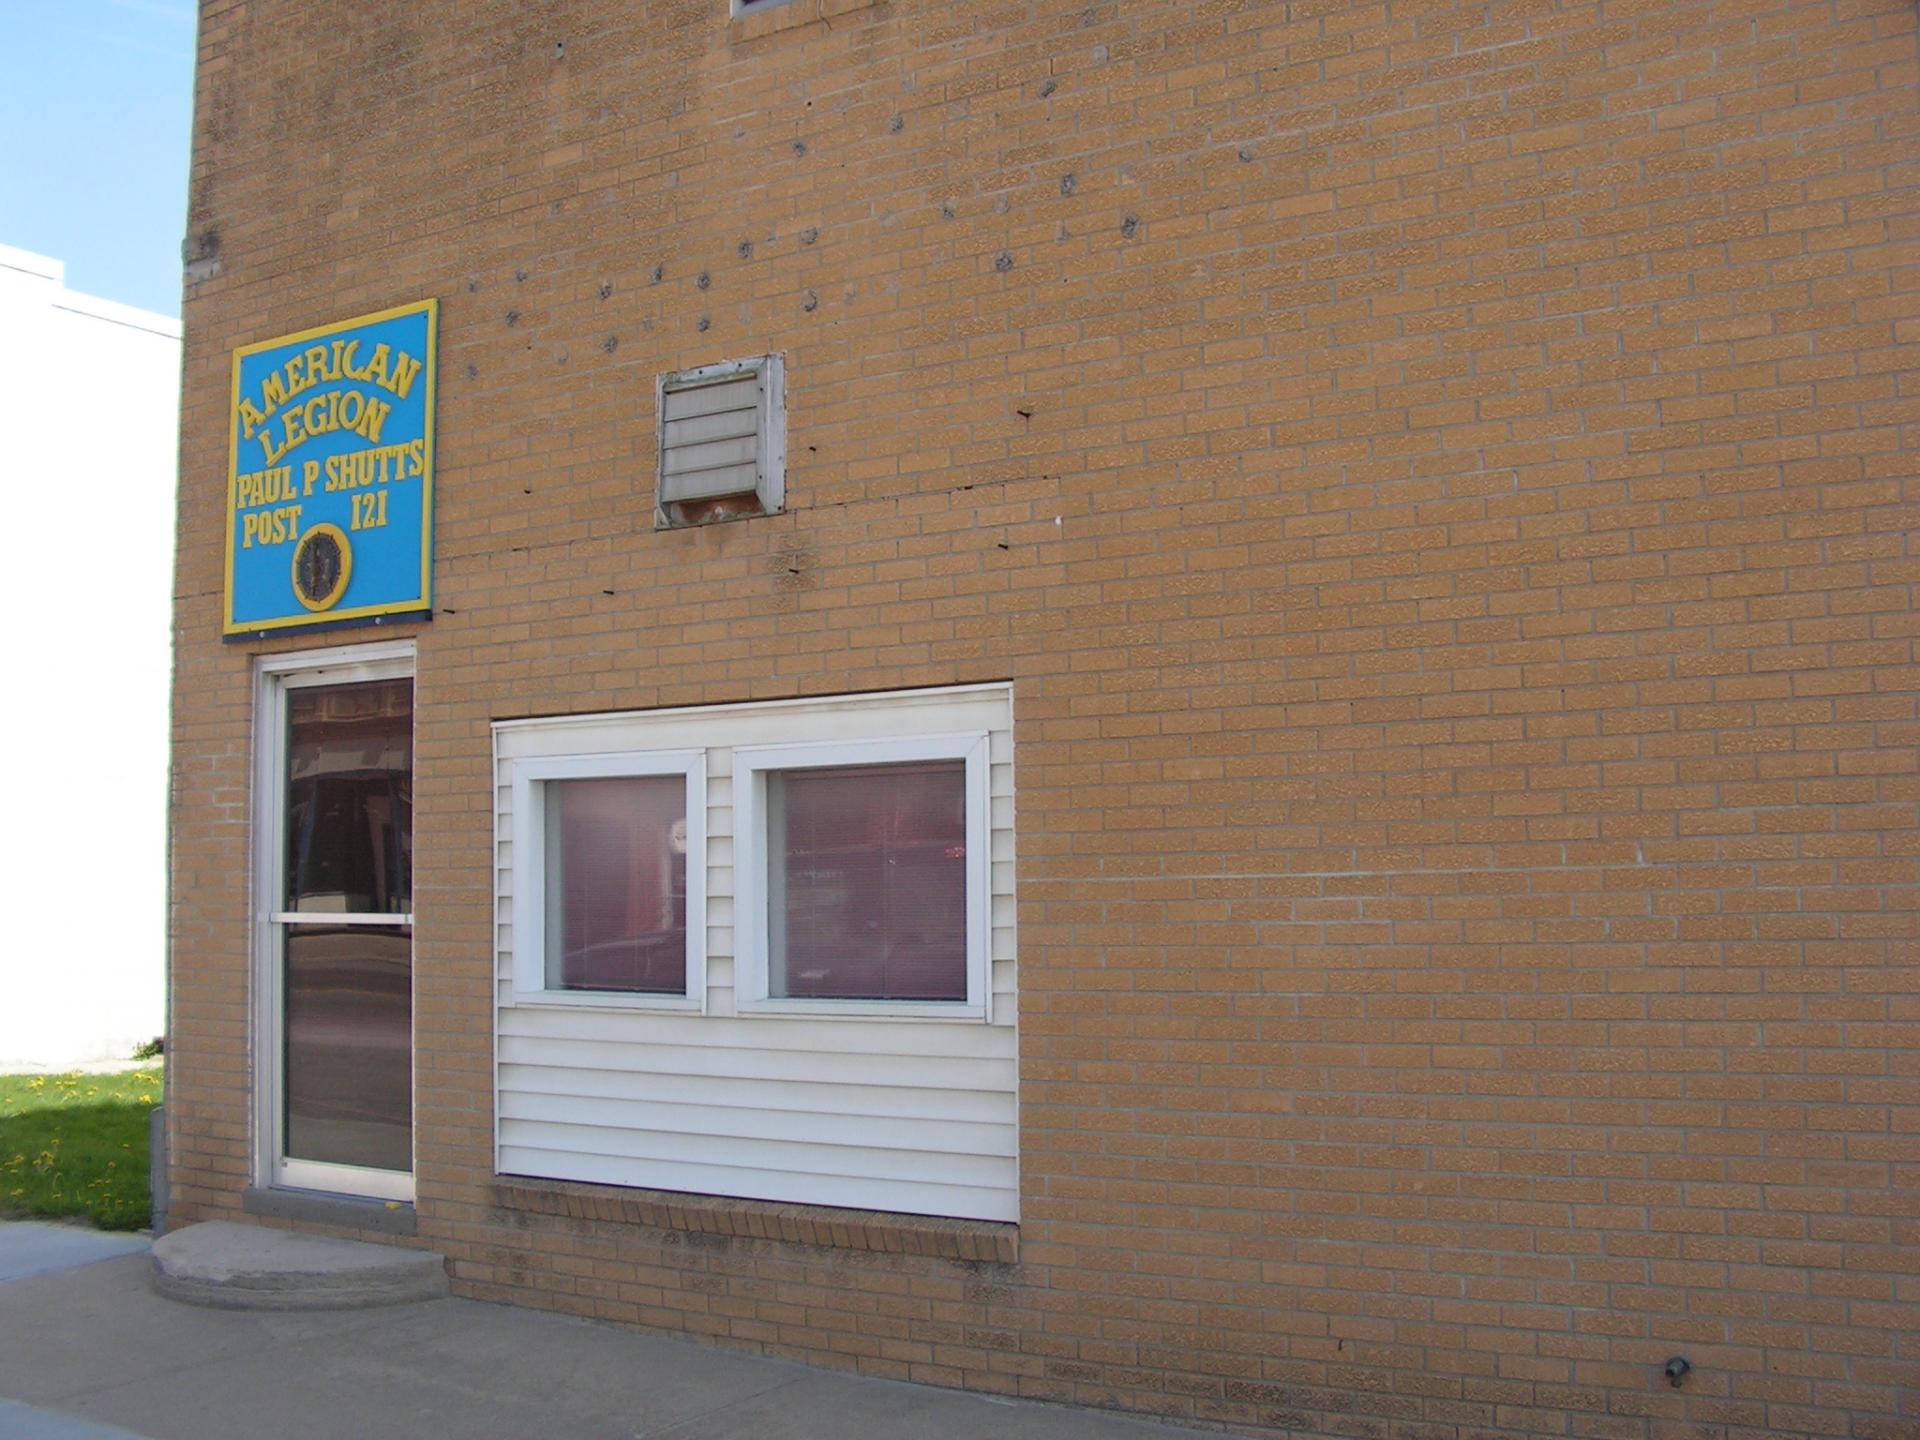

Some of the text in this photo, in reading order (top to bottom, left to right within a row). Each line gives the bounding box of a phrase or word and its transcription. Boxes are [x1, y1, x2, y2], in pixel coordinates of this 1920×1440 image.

[238, 339, 421, 439] AMERICAN
[258, 390, 391, 467] LEGION
[237, 438, 424, 509] PAUL P SHUTTS
[242, 490, 388, 548] POST 121
